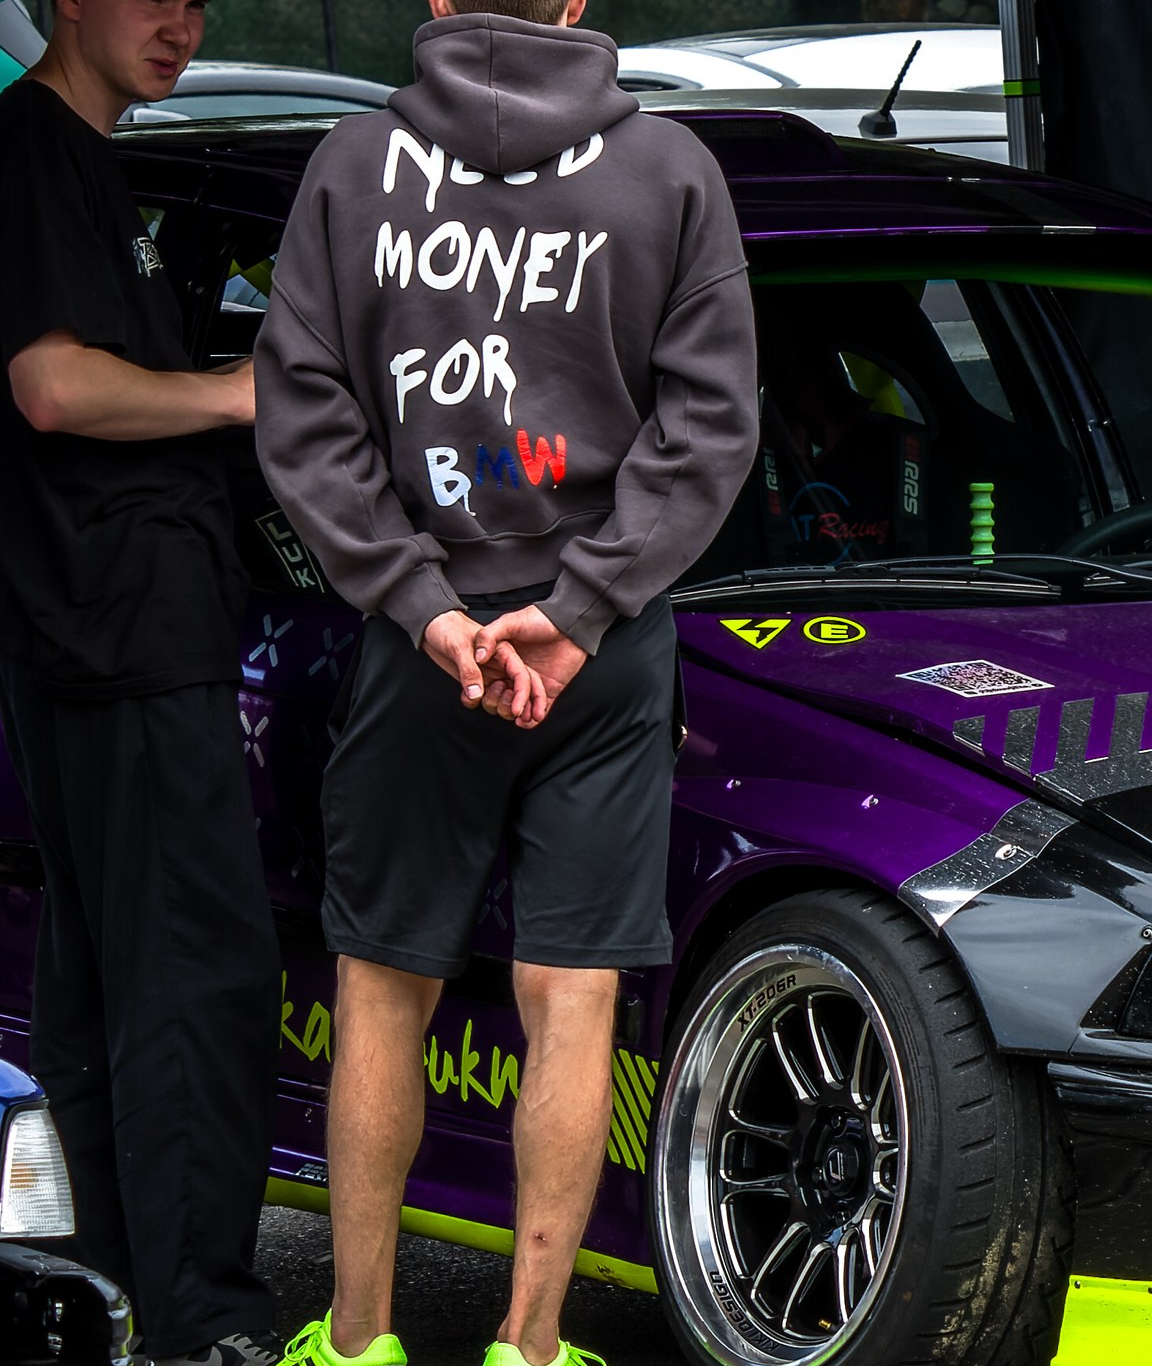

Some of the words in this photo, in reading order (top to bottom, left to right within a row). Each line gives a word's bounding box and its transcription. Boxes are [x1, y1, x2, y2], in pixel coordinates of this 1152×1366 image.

[382, 128, 604, 213] ND
[374, 220, 608, 323] MONEY
[389, 333, 518, 427] FOR
[424, 428, 567, 517] BMW
[817, 512, 892, 546] Racing
[710, 1271, 753, 1333] DESIGN
